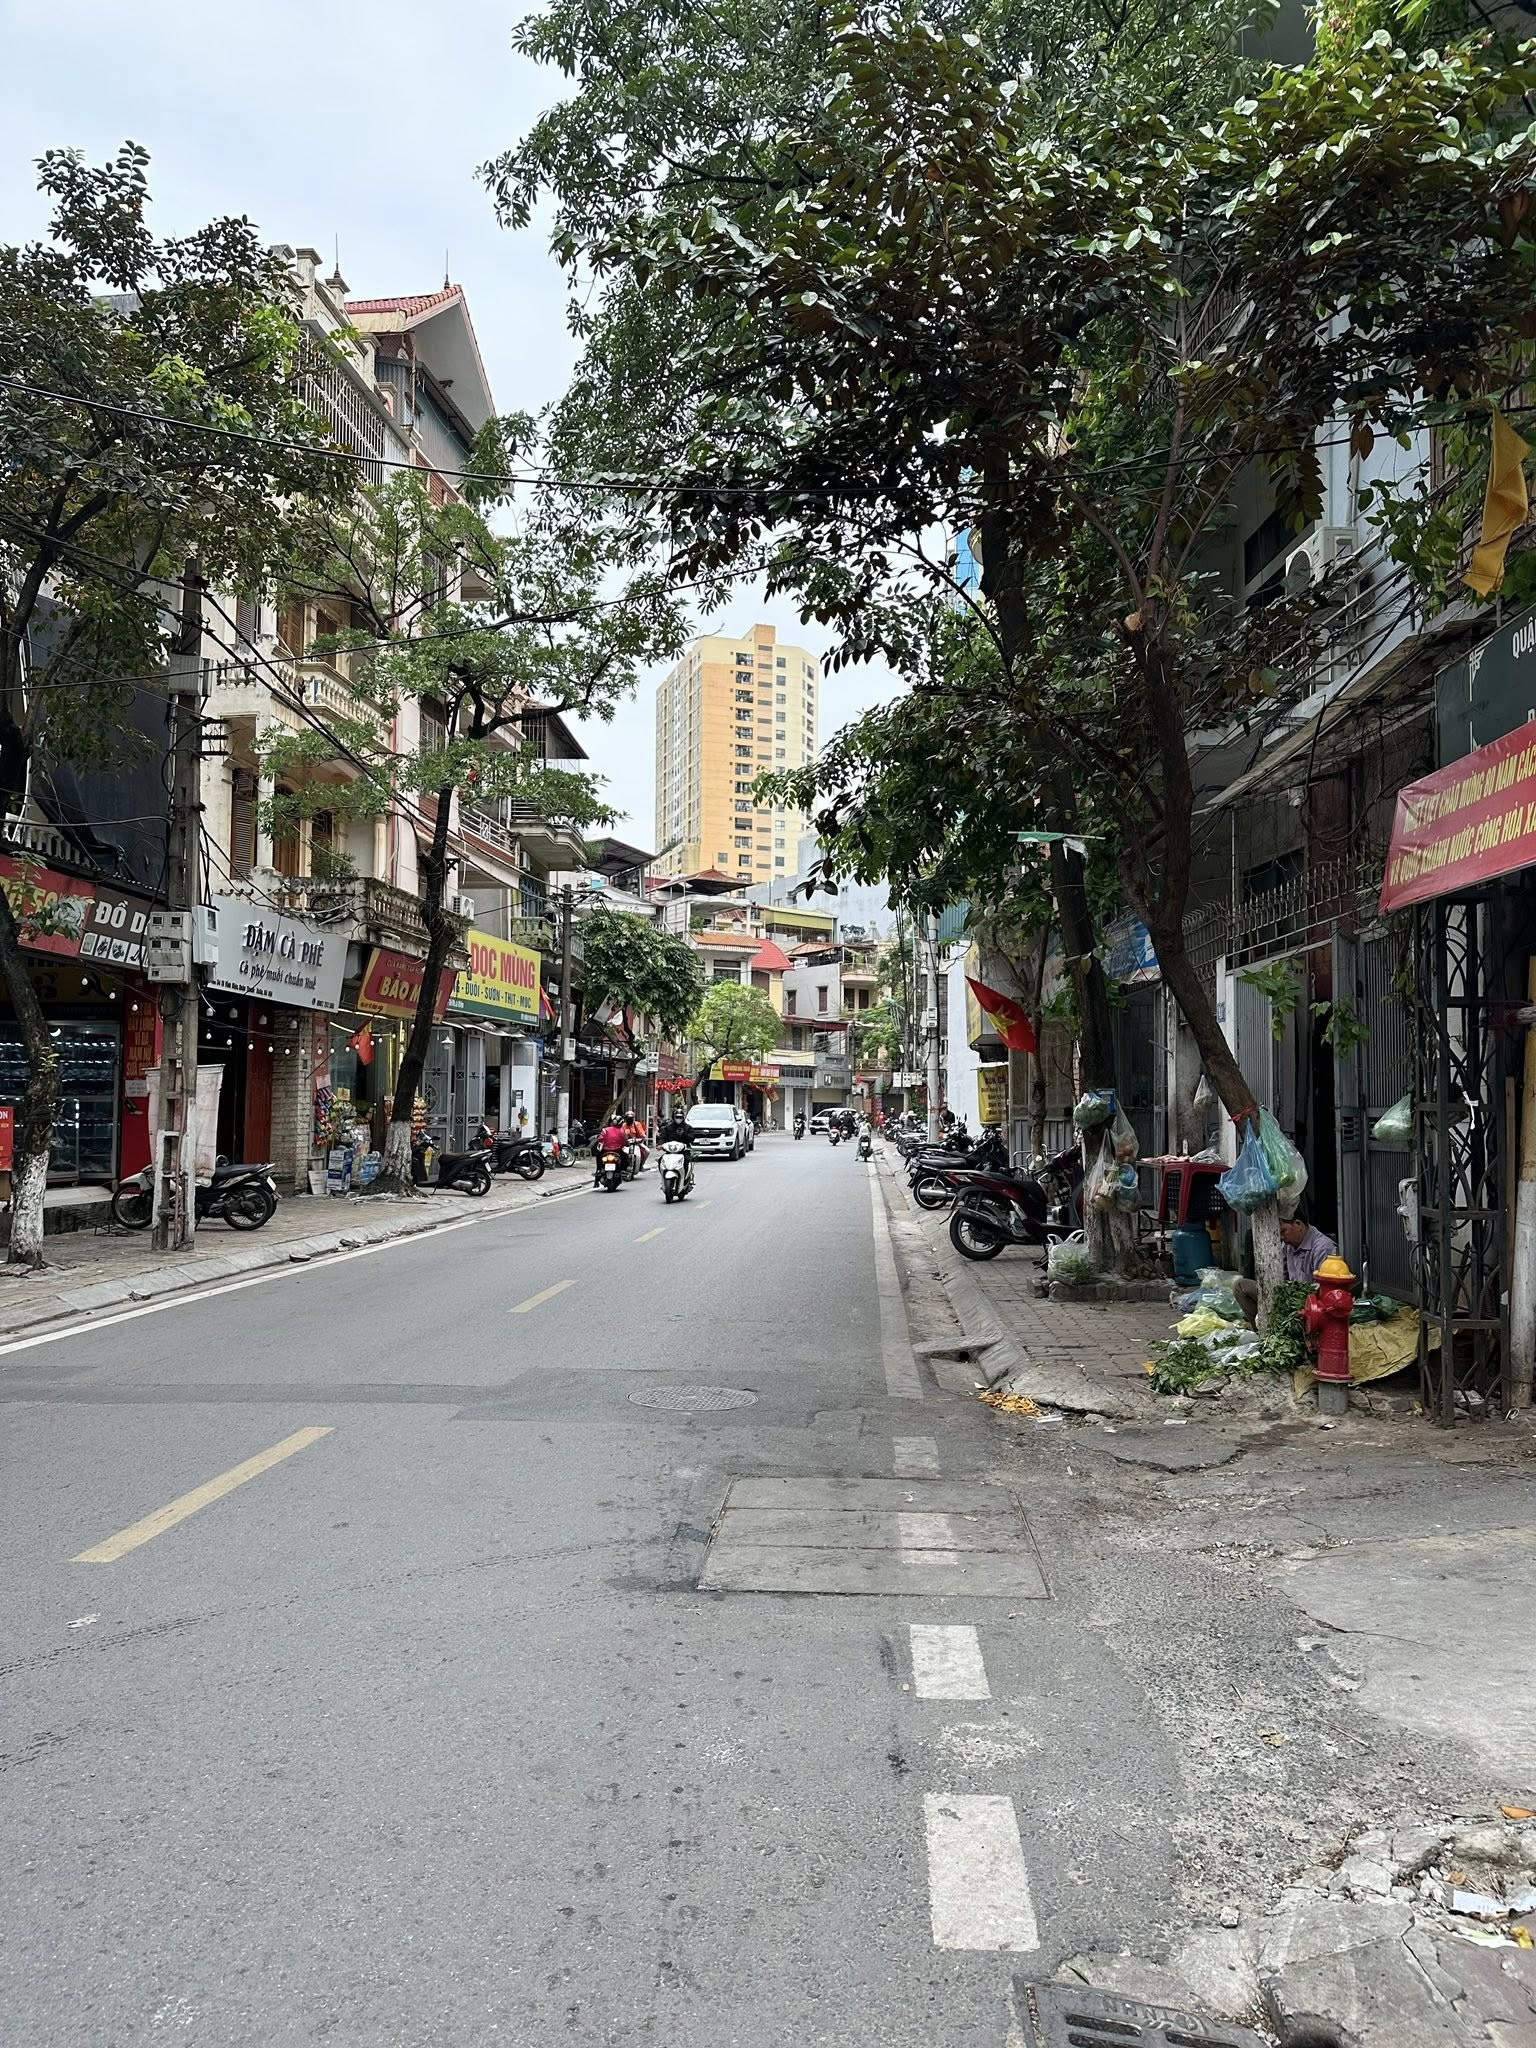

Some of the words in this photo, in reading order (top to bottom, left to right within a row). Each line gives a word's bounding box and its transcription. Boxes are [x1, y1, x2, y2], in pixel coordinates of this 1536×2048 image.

[1512, 616, 1536, 660] QUẬ
[1459, 770, 1485, 809] MỪNG
[1483, 766, 1496, 798] 80
[1494, 752, 1518, 793] NĂM
[1420, 836, 1450, 875] KHÁNH
[1448, 823, 1475, 863] NƯỚC
[1474, 815, 1502, 859] CỘNG
[1500, 801, 1524, 844] HÒA
[94, 900, 128, 929] ĐỒ
[130, 911, 148, 936] D
[243, 920, 276, 957] ĐẬM
[280, 931, 296, 960] CÀ
[300, 940, 325, 967] PHÊ
[239, 960, 249, 975] Cà
[379, 972, 410, 1000] BẢO
[500, 950, 536, 990] MÙNG
